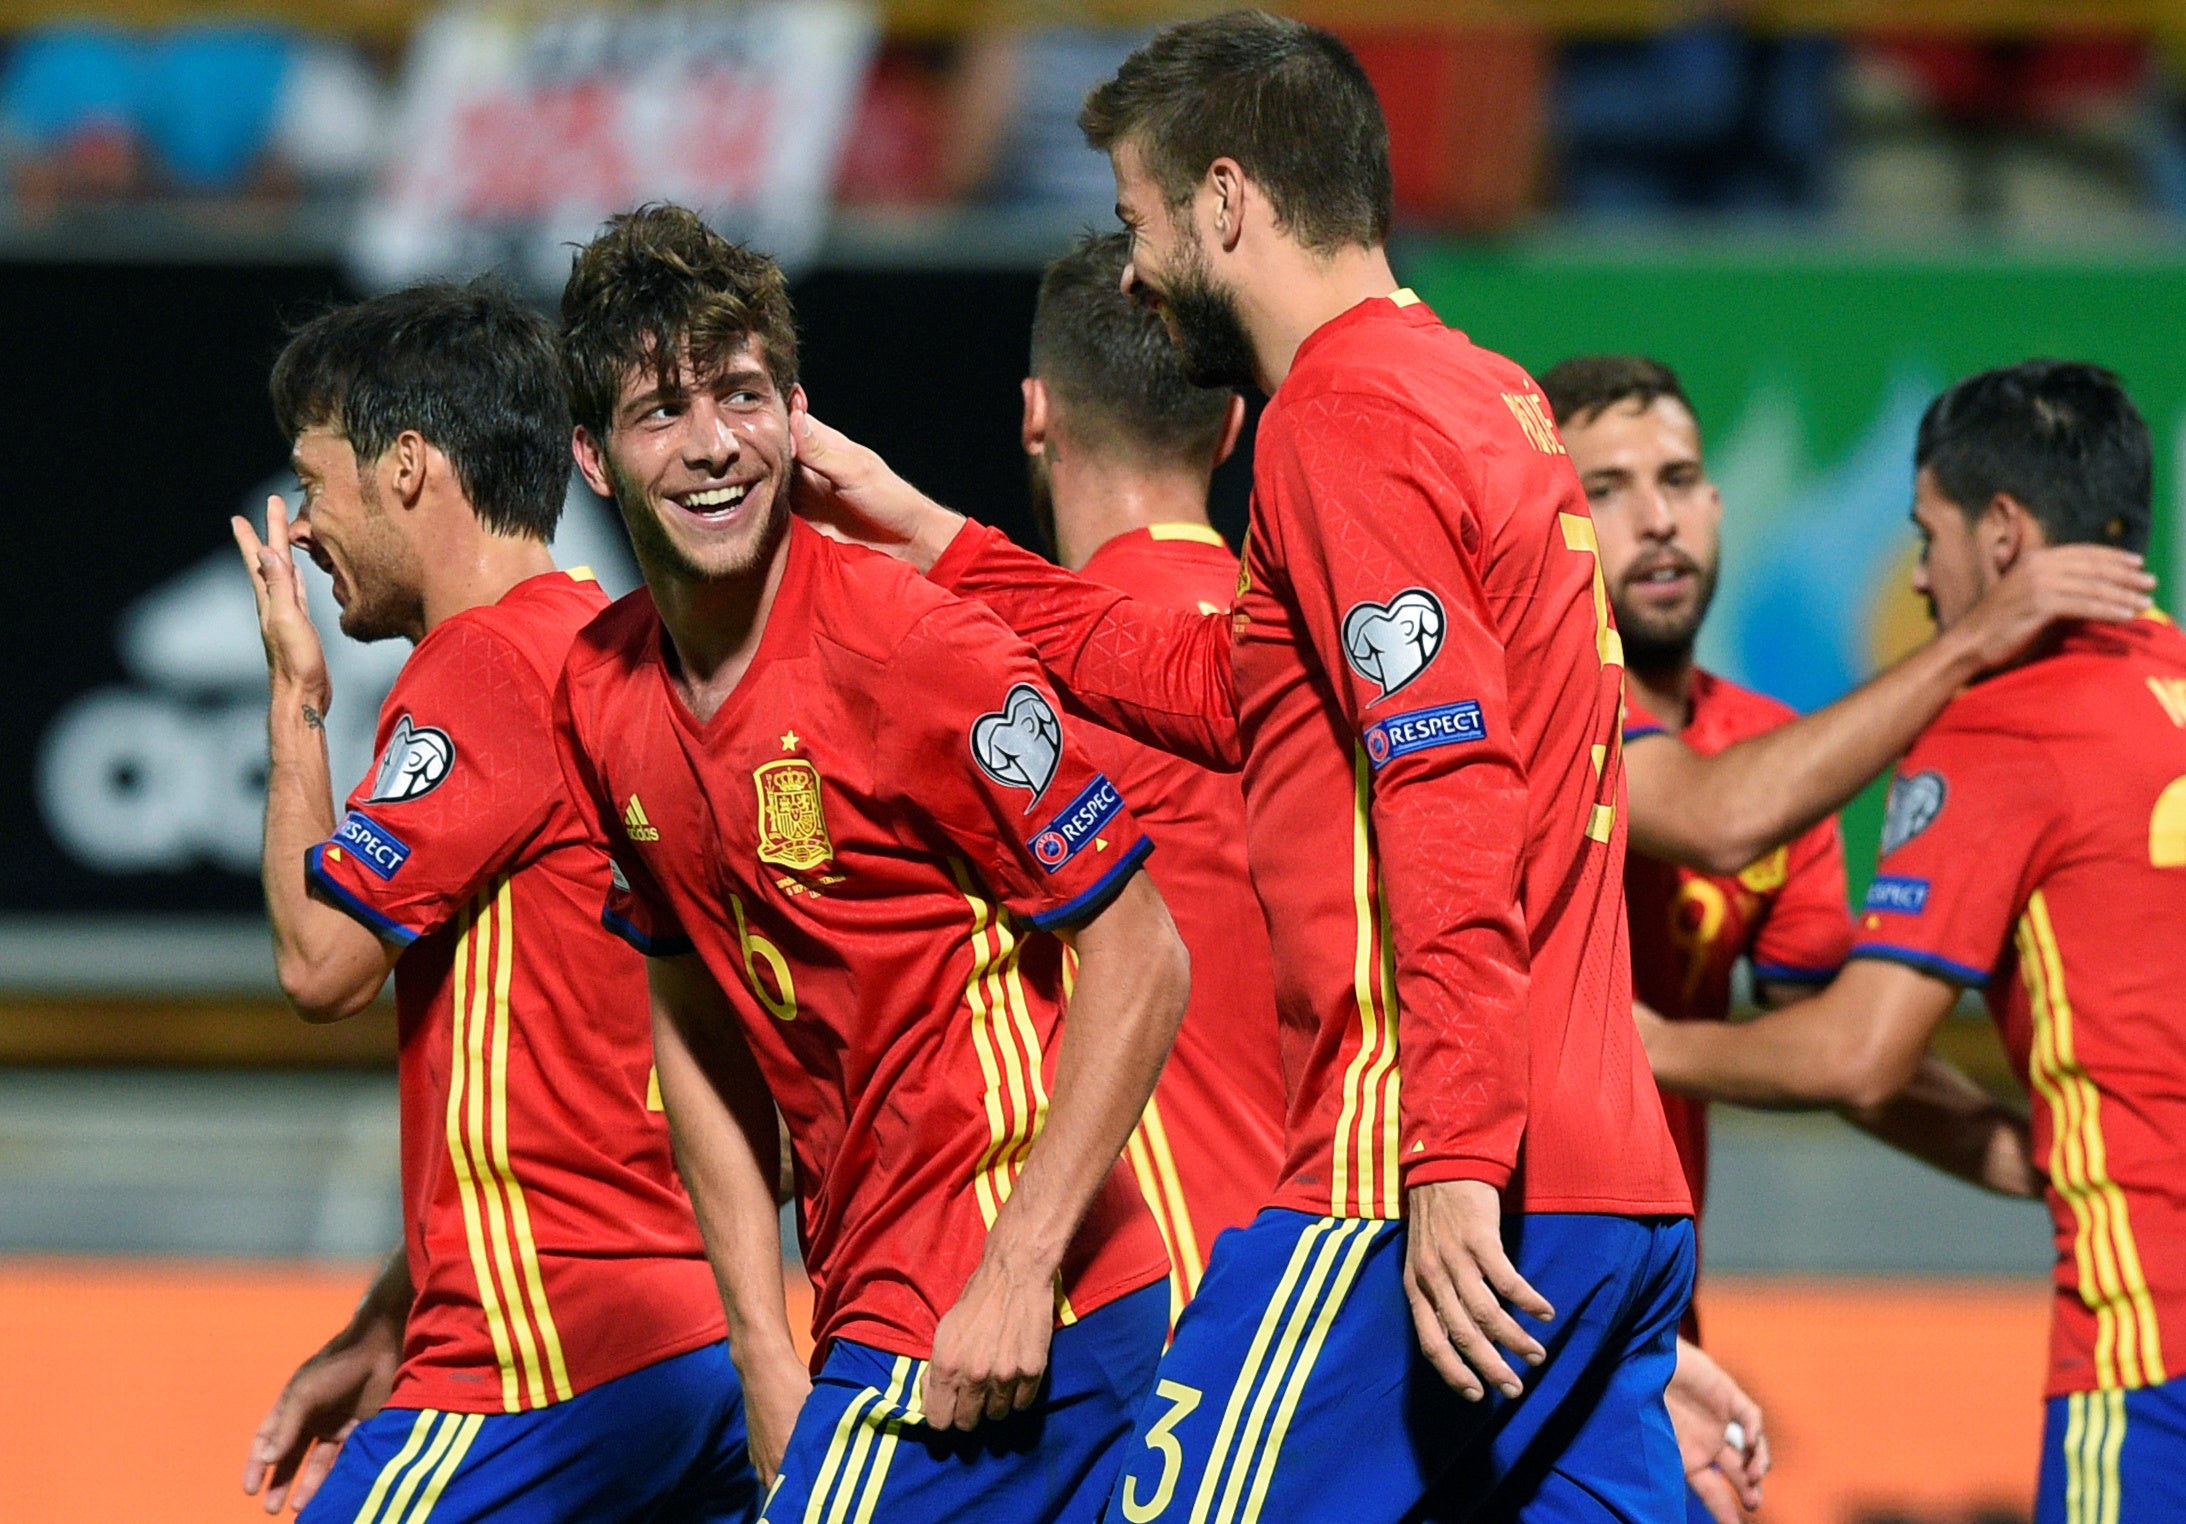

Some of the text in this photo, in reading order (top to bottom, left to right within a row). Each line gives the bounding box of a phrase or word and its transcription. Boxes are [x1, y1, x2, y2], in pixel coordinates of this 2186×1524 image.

[1389, 710, 1480, 746] RESPECT
[1061, 782, 1116, 842] RESPEC
[729, 893, 798, 1021] 6
[1122, 1378, 1203, 1524] 3
